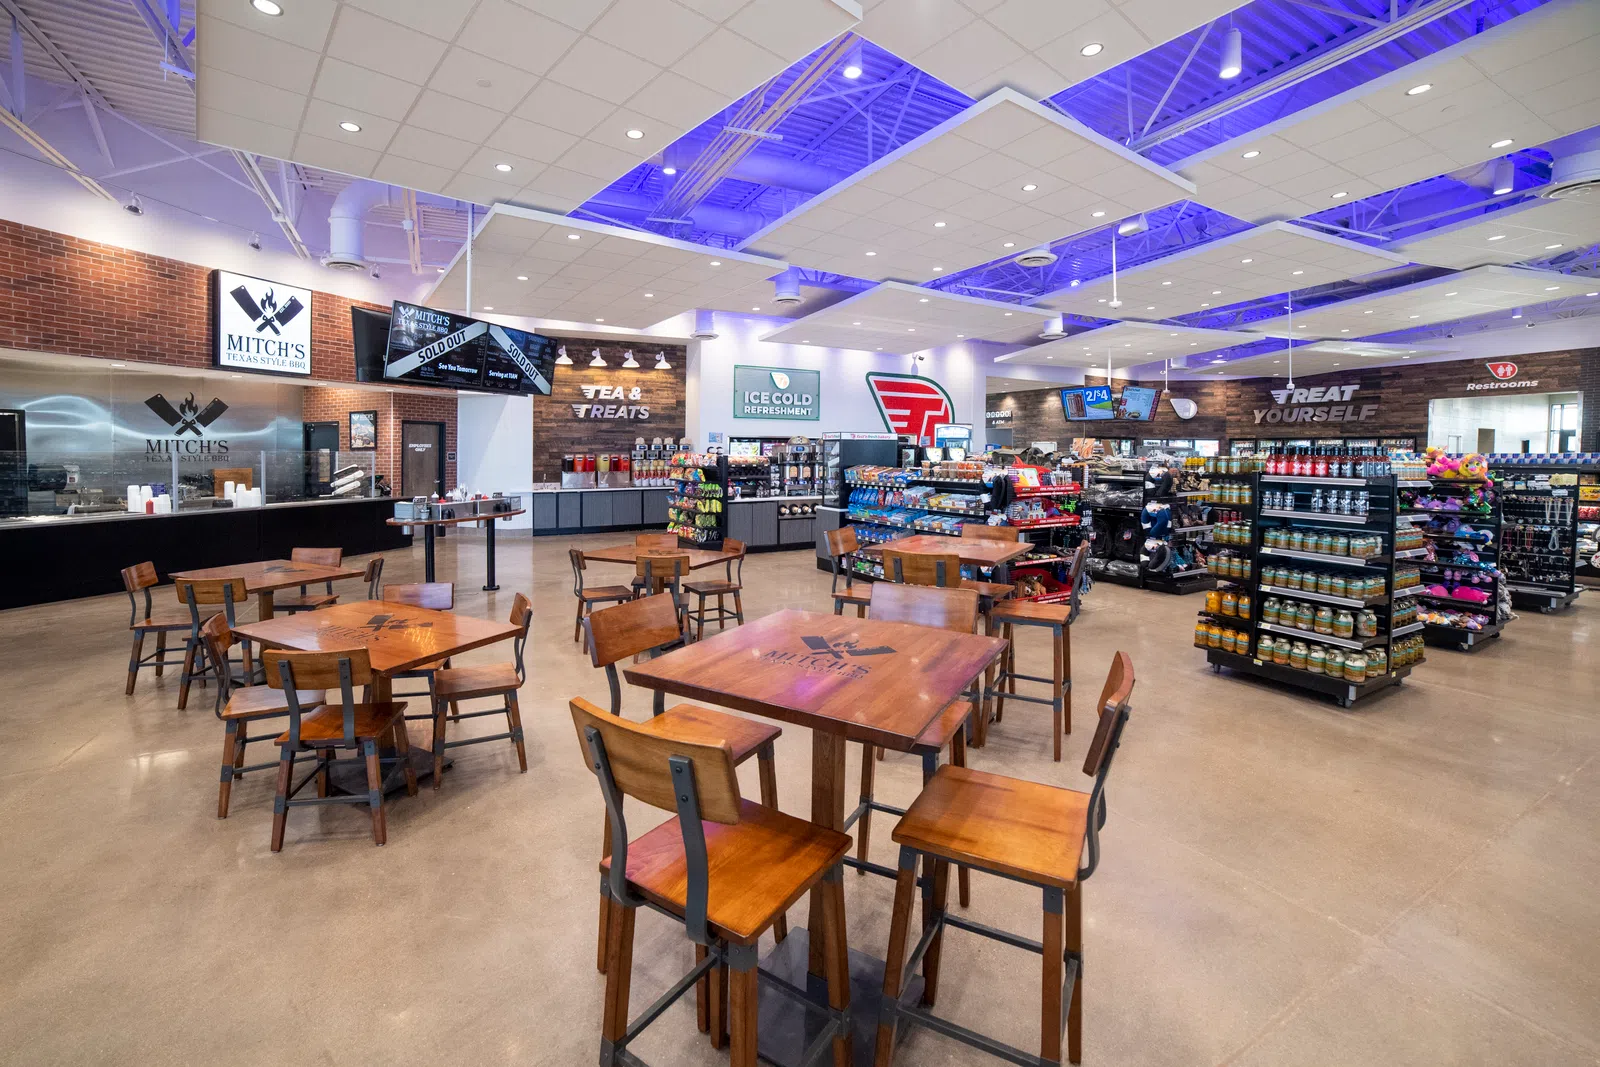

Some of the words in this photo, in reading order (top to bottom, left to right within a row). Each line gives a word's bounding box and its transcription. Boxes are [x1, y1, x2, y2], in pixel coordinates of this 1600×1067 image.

[414, 309, 450, 326] MITCH'S
[418, 322, 437, 331] STYLE
[227, 333, 305, 360] MITCH'S
[417, 340, 446, 364] SOLD
[446, 330, 466, 349] OUT
[226, 352, 259, 364] TEXAS
[259, 356, 287, 367] STYLE
[289, 360, 306, 370] BBQ
[438, 362, 448, 370] See
[448, 363, 456, 371] You
[456, 364, 478, 374] Tomorrow
[507, 343, 526, 367] SOLD
[525, 362, 540, 381] OUT
[488, 370, 504, 379] Serving
[580, 385, 625, 400] TEA
[628, 386, 642, 400] &
[1466, 380, 1539, 391] Restrooms
[744, 391, 770, 404] ICE
[771, 392, 813, 406] COLD
[1270, 384, 1360, 405] TREAT
[571, 404, 650, 420] TREATS
[744, 405, 813, 416] REFRESHMENT
[1253, 404, 1379, 424] YOURSELF
[145, 438, 229, 455] MITCH'S
[144, 455, 173, 463] TEXA
[763, 650, 873, 675] MITCH'S
